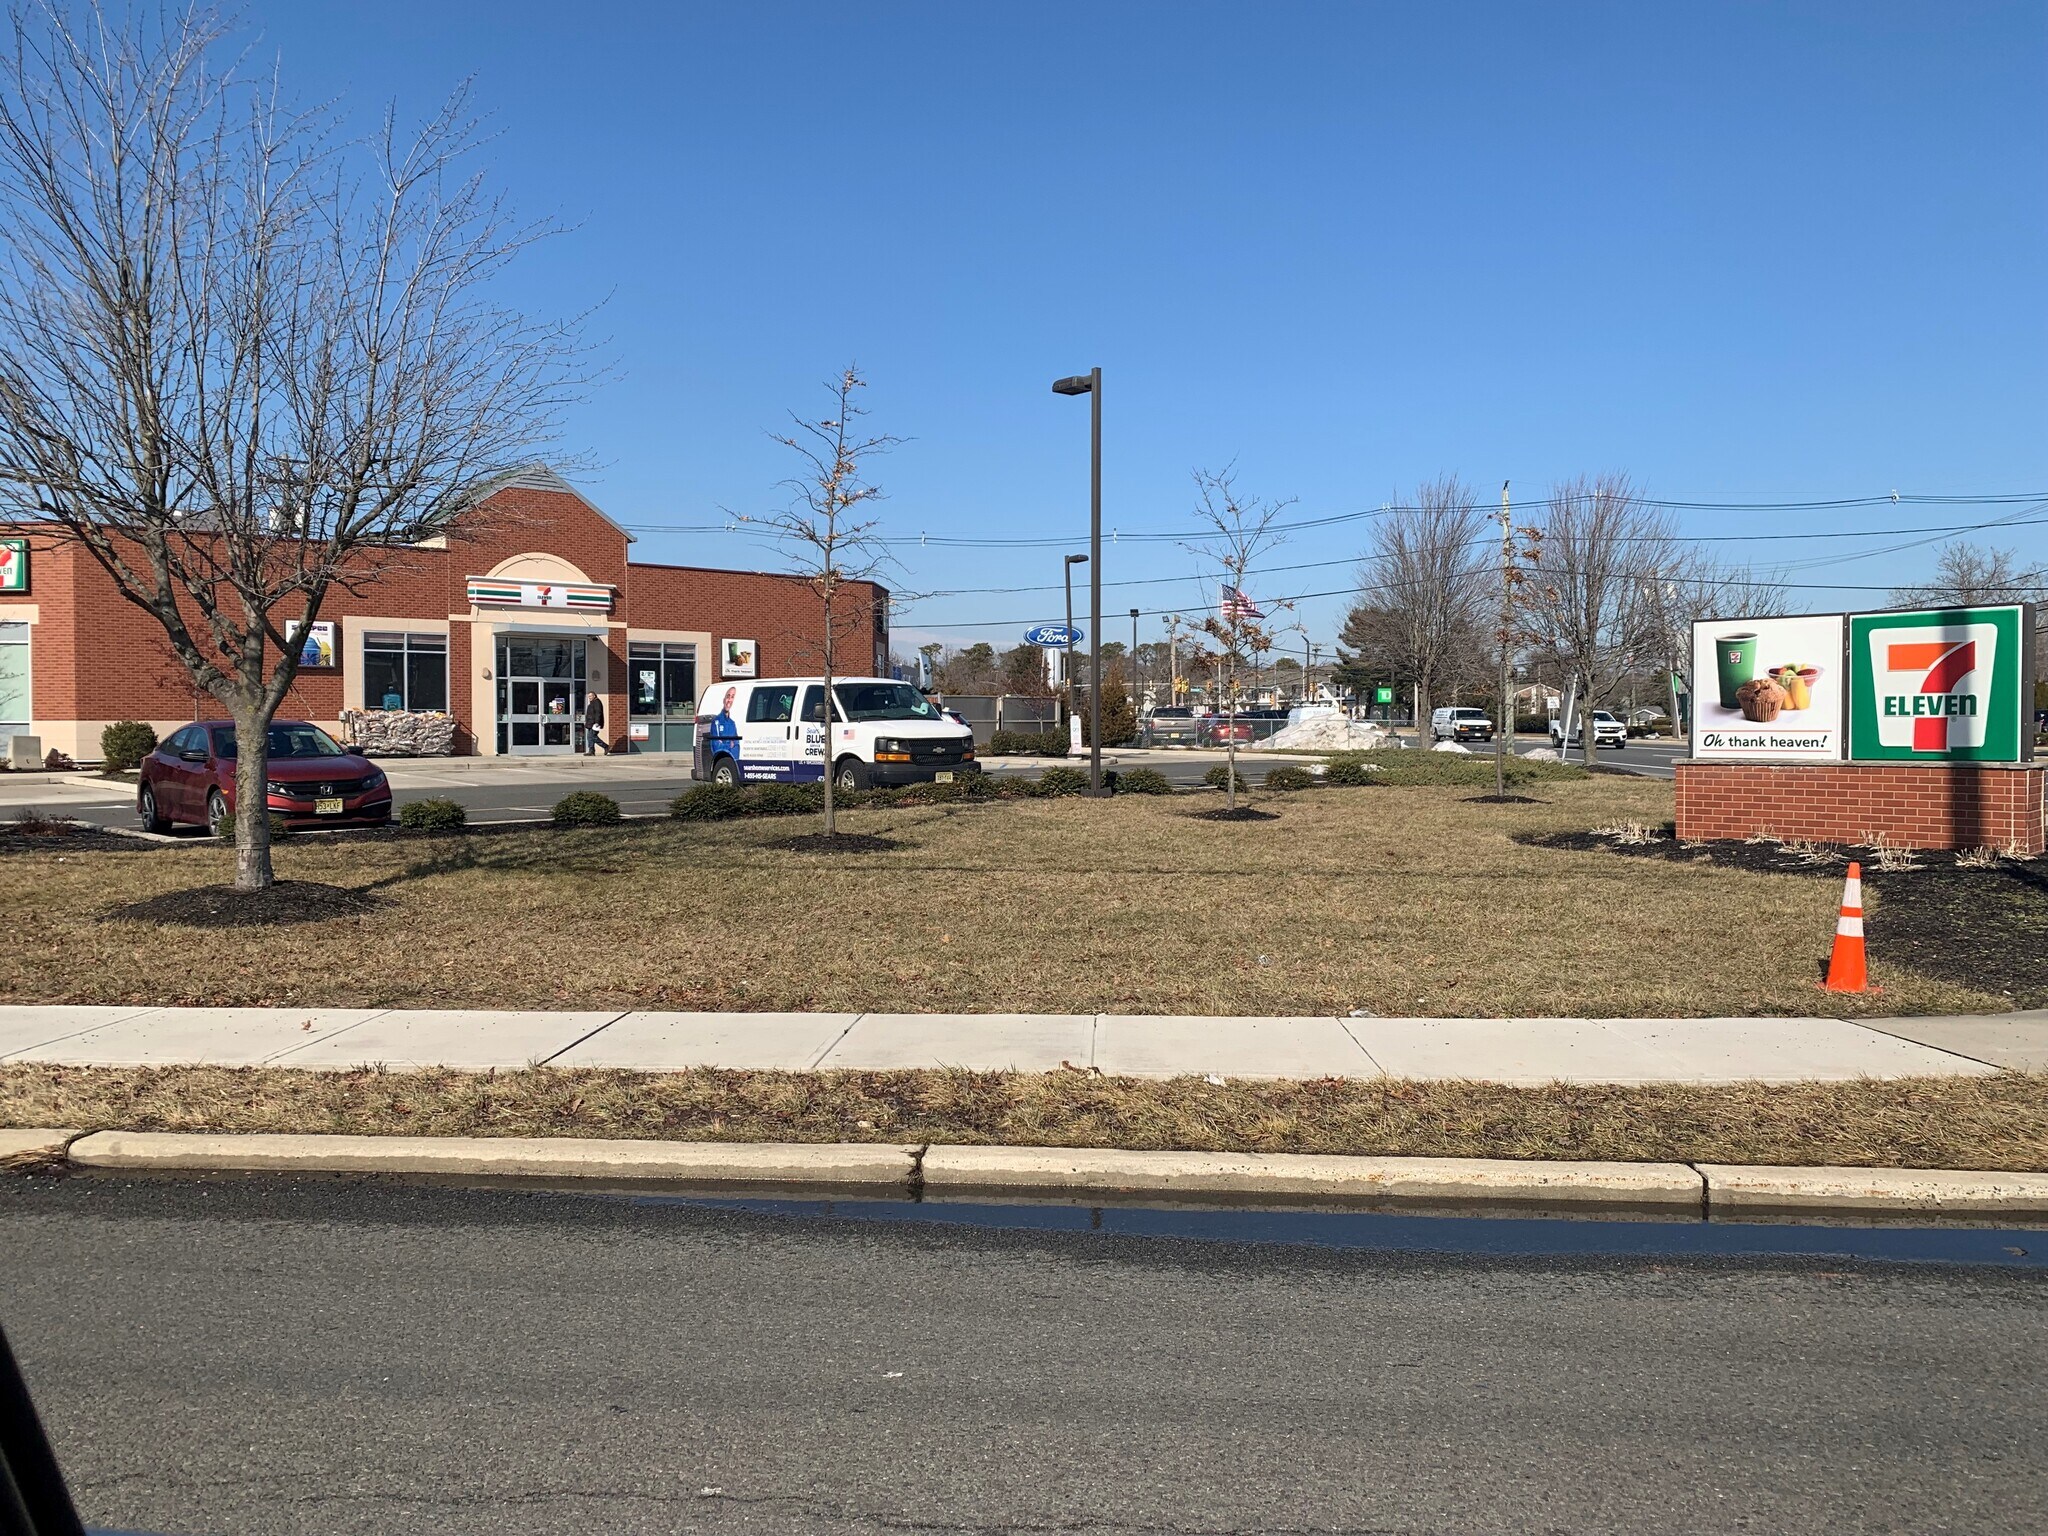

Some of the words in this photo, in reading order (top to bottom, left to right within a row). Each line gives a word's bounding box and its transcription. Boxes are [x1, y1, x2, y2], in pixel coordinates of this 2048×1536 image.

[1703, 733, 1725, 747] Oh
[1728, 735, 1766, 747] thank
[1770, 734, 1828, 748] heaven!
